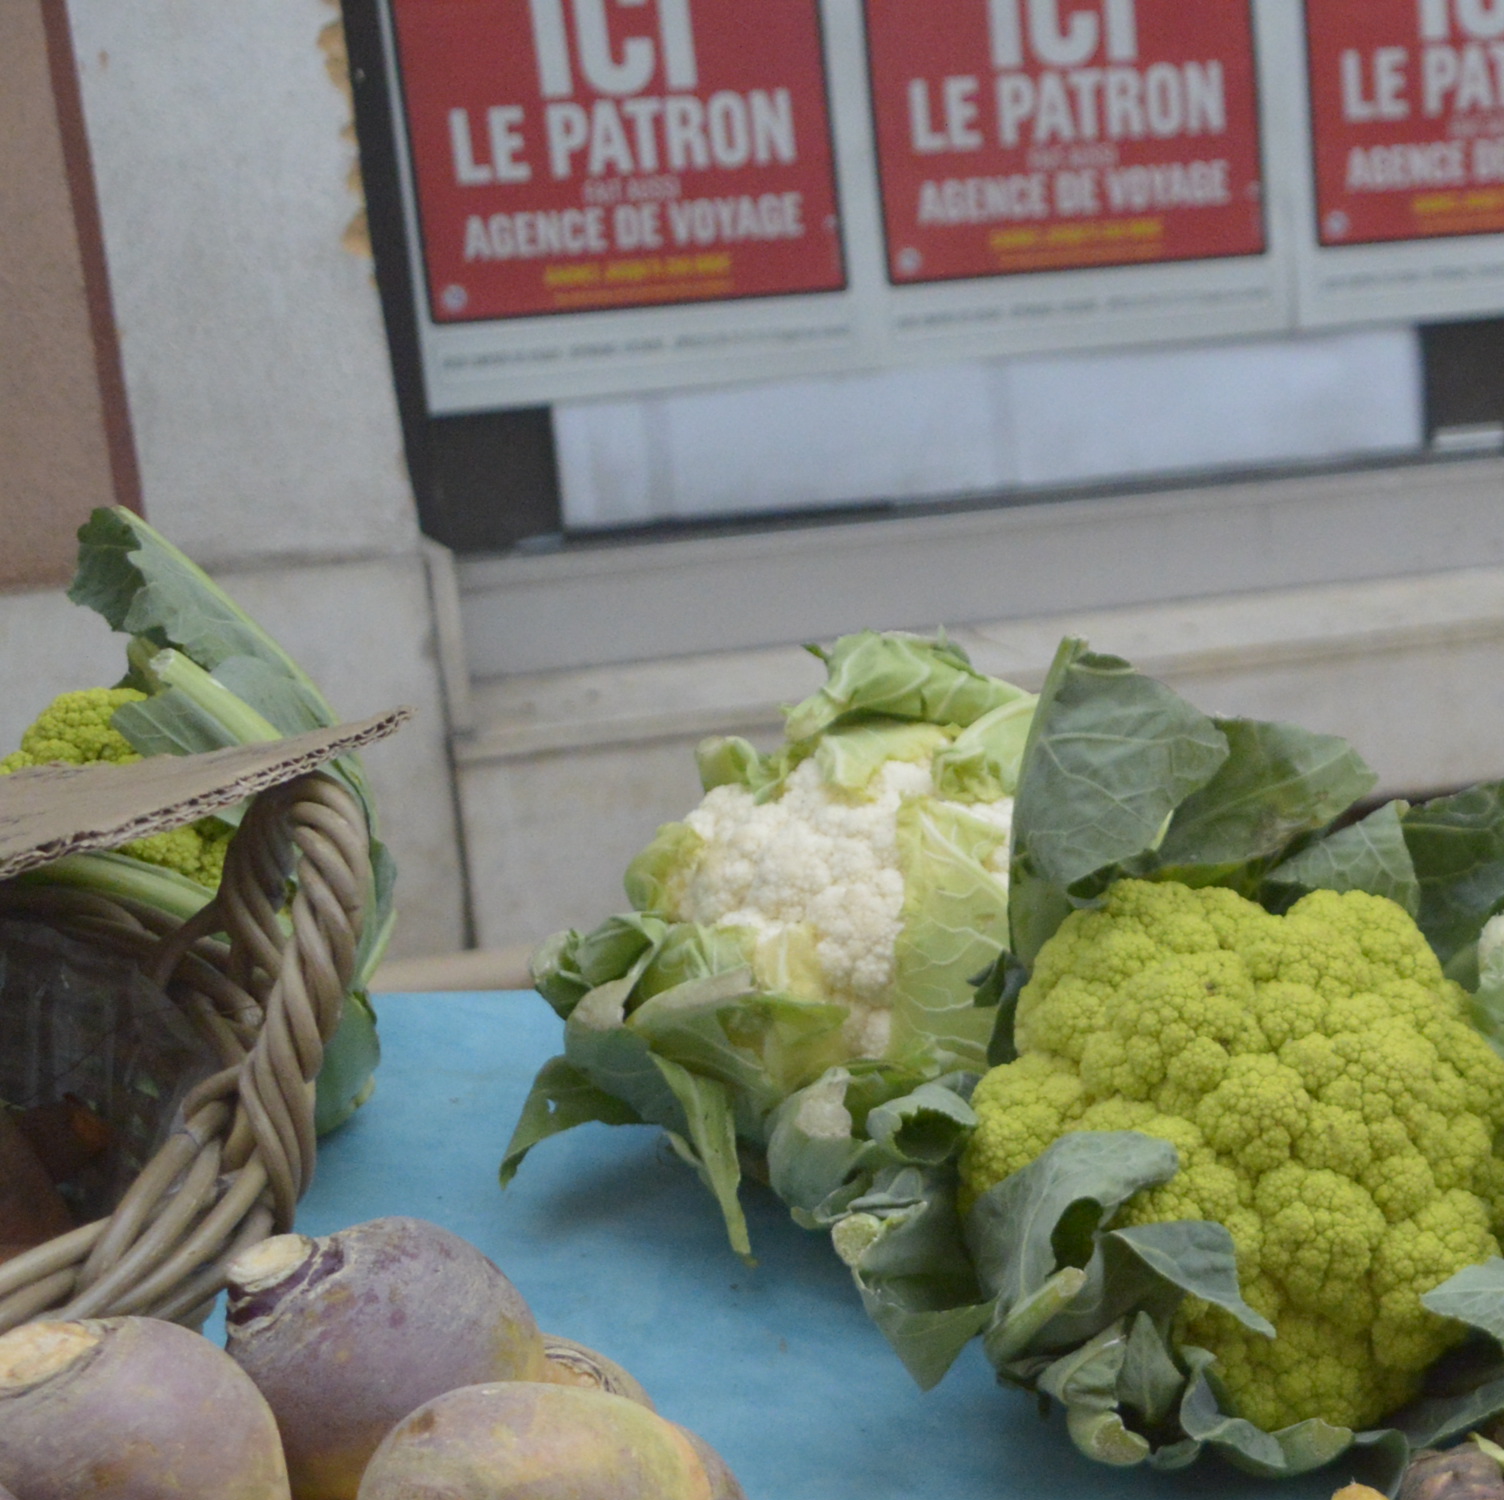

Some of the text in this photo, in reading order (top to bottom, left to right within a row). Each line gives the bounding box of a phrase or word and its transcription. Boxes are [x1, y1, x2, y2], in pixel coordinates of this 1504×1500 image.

[530, 0, 698, 99] ICI
[1340, 46, 1410, 124] LE
[448, 87, 796, 187] LE PATRON
[908, 60, 1225, 154] LE PATRON
[917, 159, 1231, 227] AGENCE DE VOYAGE
[1344, 140, 1467, 193] AGENCE
[464, 192, 803, 262] AGENCE DE VOYAGE
